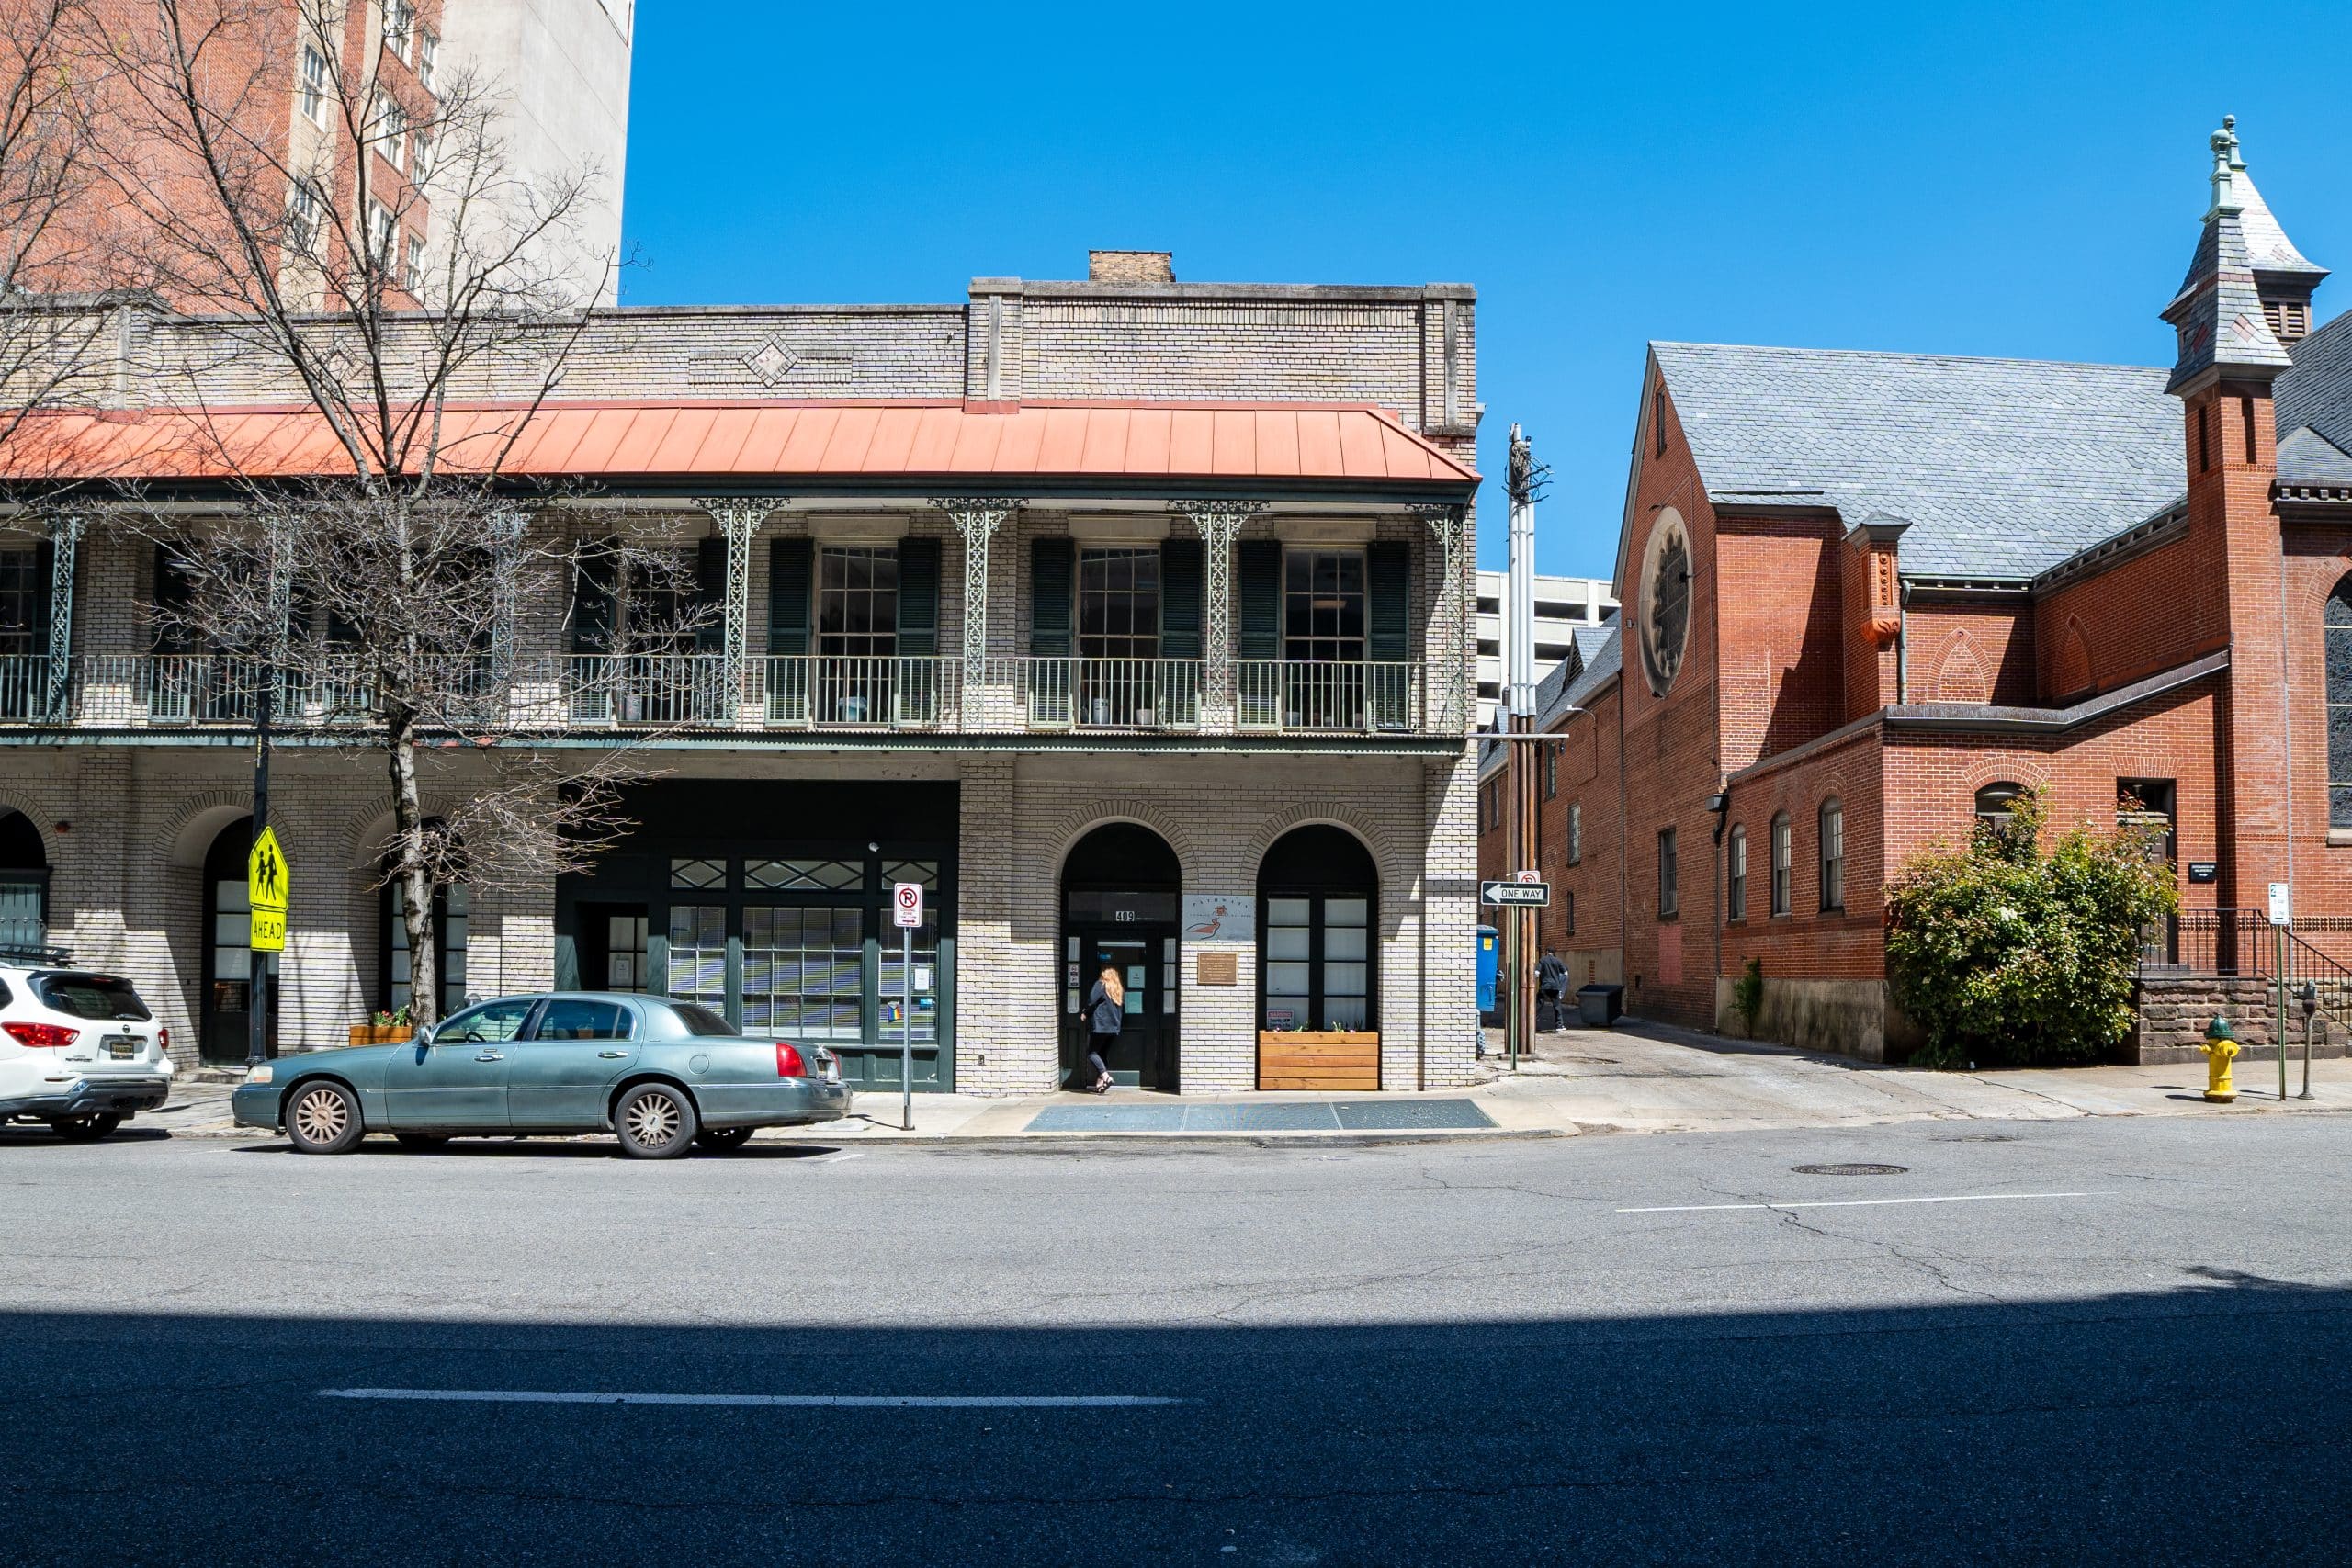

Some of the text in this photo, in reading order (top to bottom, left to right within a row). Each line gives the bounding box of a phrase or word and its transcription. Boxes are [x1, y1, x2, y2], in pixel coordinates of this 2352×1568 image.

[1501, 888, 1541, 898] ONE WAY
[1116, 911, 1134, 921] 409
[254, 920, 282, 940] AHEAD
